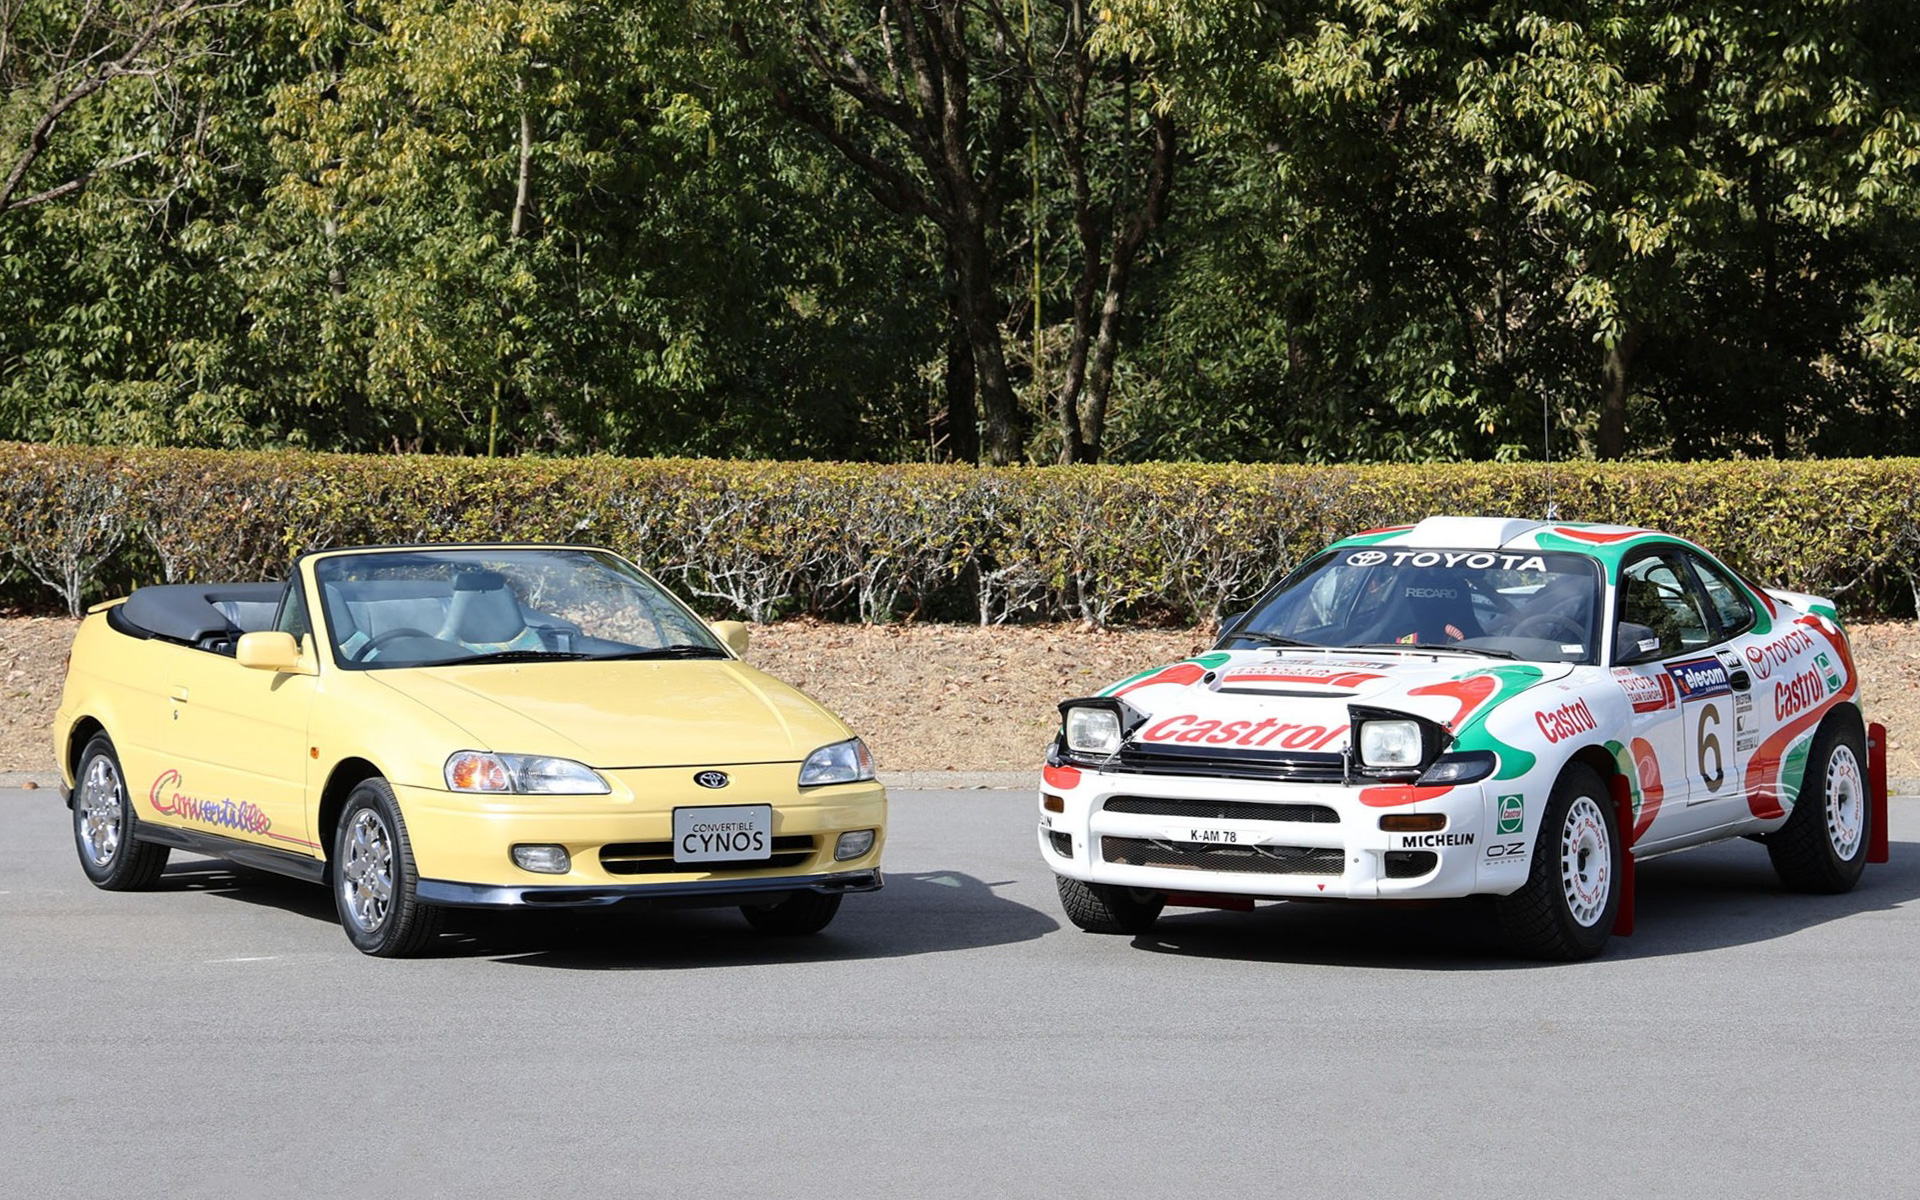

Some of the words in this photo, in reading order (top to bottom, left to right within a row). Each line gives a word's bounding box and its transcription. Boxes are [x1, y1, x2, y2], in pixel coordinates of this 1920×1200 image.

[1392, 552, 1547, 572] TOYOTA
[1405, 587, 1457, 599] RECARO
[1765, 630, 1814, 667] TOYOTA
[1618, 676, 1657, 692] TOYOTA
[1774, 663, 1824, 721] Castrol
[1628, 692, 1644, 702] TEAM
[1642, 689, 1663, 701] EUROPE
[1534, 697, 1598, 744] Castrol
[1142, 714, 1352, 750] Castrol
[1698, 703, 1723, 793] 6
[149, 769, 272, 835] Convertible
[1503, 809, 1521, 819] Castrol
[692, 822, 754, 833] CONVERTIBLE
[1190, 829, 1219, 842] K-AM
[1223, 831, 1237, 843] 78
[682, 831, 763, 854] CYNOS
[1402, 833, 1475, 848] MICHELIN
